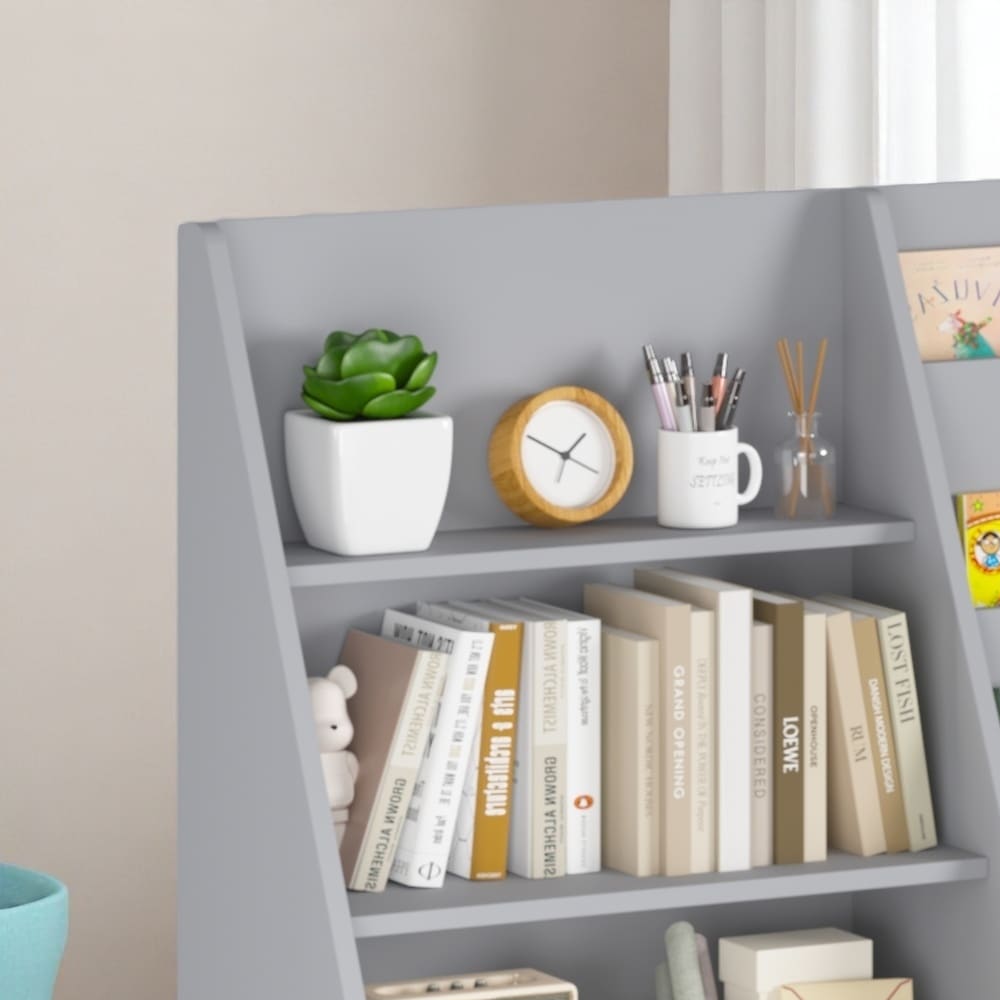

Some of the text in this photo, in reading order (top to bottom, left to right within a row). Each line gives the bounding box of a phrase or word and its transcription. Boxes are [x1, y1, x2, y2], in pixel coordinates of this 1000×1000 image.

[886, 620, 915, 724] LOST FISH
[673, 664, 686, 800] GRAND OPENING
[753, 692, 767, 799] CONSIDERED
[782, 715, 800, 774] LOEWE
[809, 704, 819, 768] OPENHOUSE
